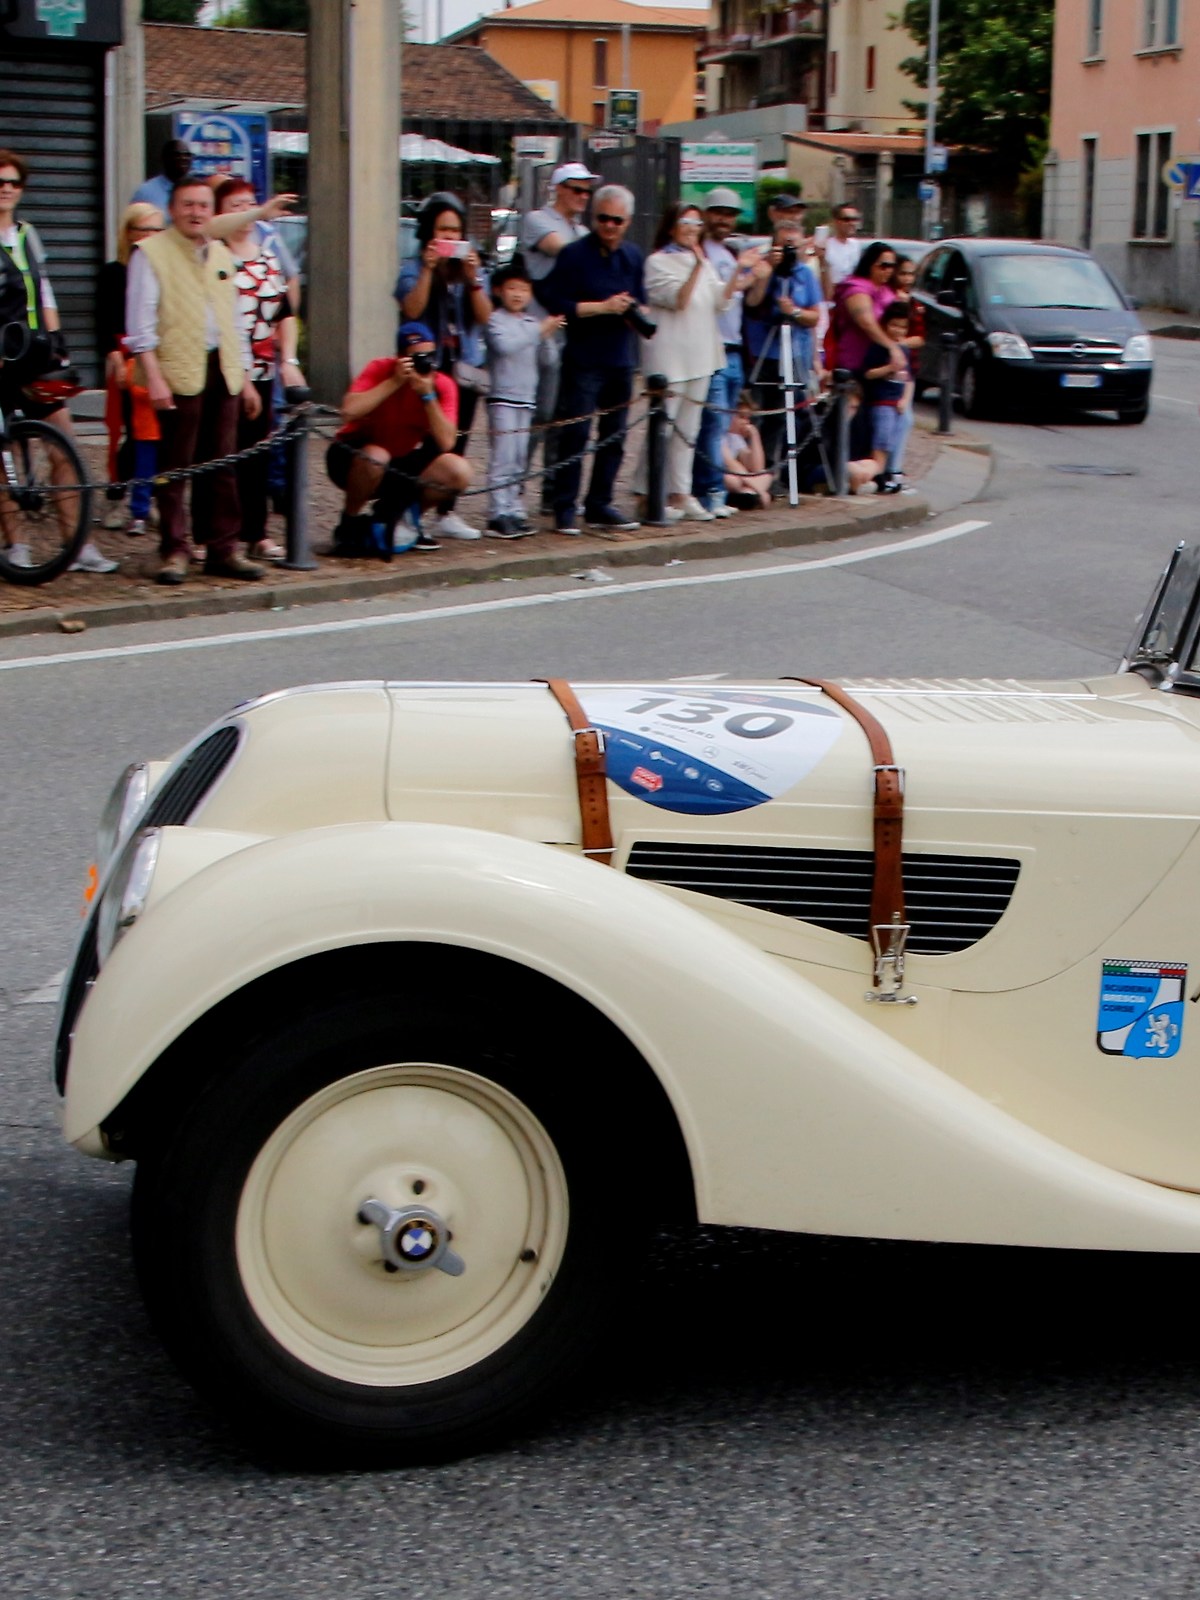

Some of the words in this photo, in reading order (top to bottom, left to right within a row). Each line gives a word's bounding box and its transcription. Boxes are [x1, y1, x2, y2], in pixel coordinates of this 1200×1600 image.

[624, 697, 794, 740] 130
[1103, 984, 1154, 993] SCUDERIA
[1102, 993, 1147, 1003] BRESCIA
[1102, 1004, 1135, 1013] CORSE
